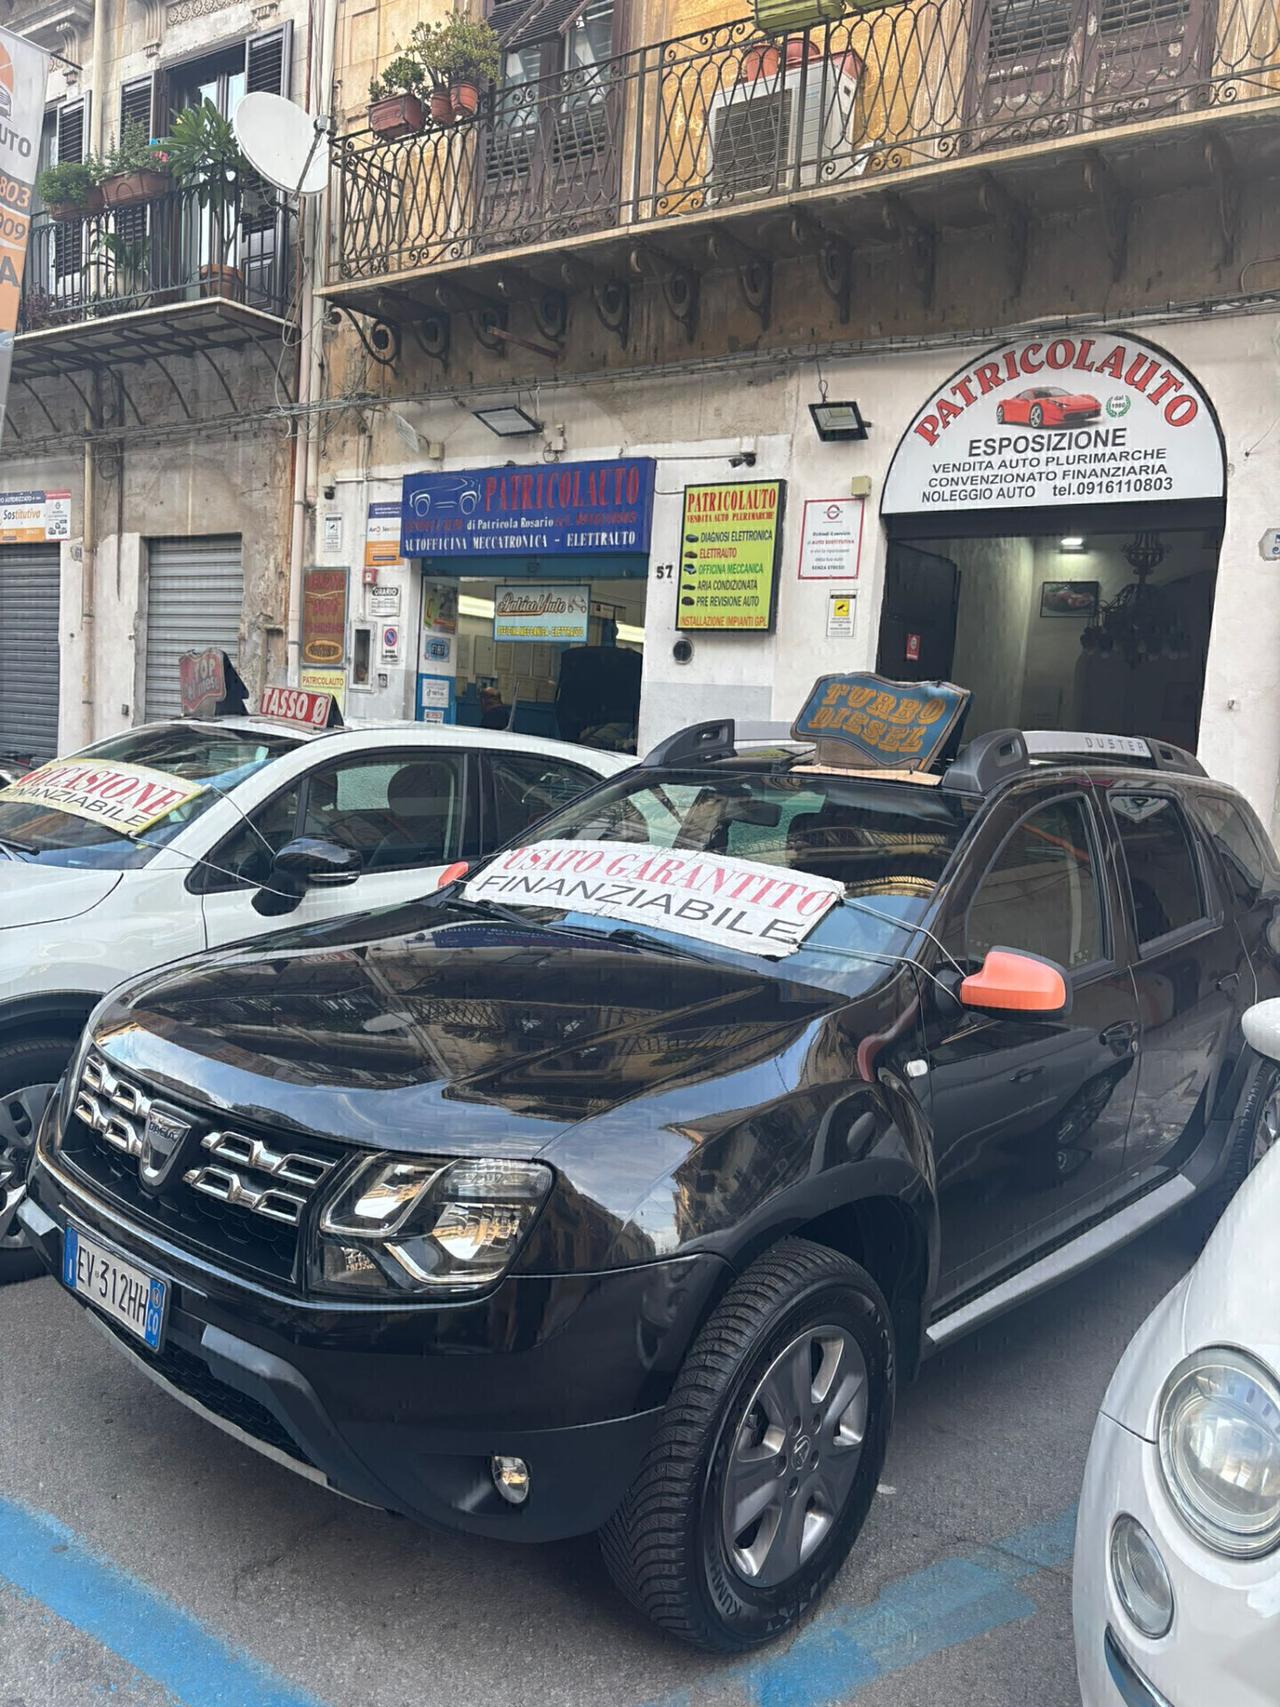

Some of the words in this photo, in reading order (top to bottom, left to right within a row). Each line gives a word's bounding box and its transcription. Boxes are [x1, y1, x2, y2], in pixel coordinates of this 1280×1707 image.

[913, 338, 1199, 447] PATRICOLAUTO
[968, 427, 1127, 458] ESPOSIZIONE
[932, 460, 994, 474] VENDITA
[999, 457, 1041, 470] AUTO
[1045, 448, 1167, 468] PLURIMARCHE
[928, 470, 1058, 488] CONVENZIONATO
[1062, 463, 1168, 481] FINANZIARIA
[484, 467, 640, 512] PATRICOLAUTO
[687, 487, 777, 513] PATRICOLAUTO
[921, 487, 993, 503] NOLEGGIO
[996, 485, 1036, 500] AUTO
[1052, 476, 1174, 497] tel.0916110803
[466, 520, 476, 531] di
[477, 518, 518, 531] Patricola
[520, 516, 554, 529] Rosario
[700, 531, 730, 543] DIAGNOSI
[731, 529, 773, 542] ELETTRONICA
[404, 538, 467, 552] AUTOFFICINA
[472, 534, 548, 550] MECCATRONICA
[566, 531, 636, 548] ELETTRAUTO
[699, 547, 737, 559] ELETTRAUTO
[656, 565, 673, 579] 57
[698, 563, 726, 574] OFFICINA
[727, 562, 764, 574] MECCANICA
[373, 587, 399, 596] ORARIO
[697, 580, 712, 591] ARIA
[713, 579, 758, 591] CONDIZIONATA
[696, 596, 710, 607] PRE
[710, 595, 742, 607] REVISIONE
[743, 595, 760, 607] AUTO
[302, 676, 344, 686] PATRICOLAUTO
[261, 686, 309, 720] TASSO
[822, 683, 946, 725] TURBO
[808, 707, 927, 752] DIESEL
[1085, 736, 1146, 753] DUSTER
[502, 848, 605, 871] USATO
[605, 853, 833, 917] GARANTITO
[476, 874, 805, 940] FINANZIABILE
